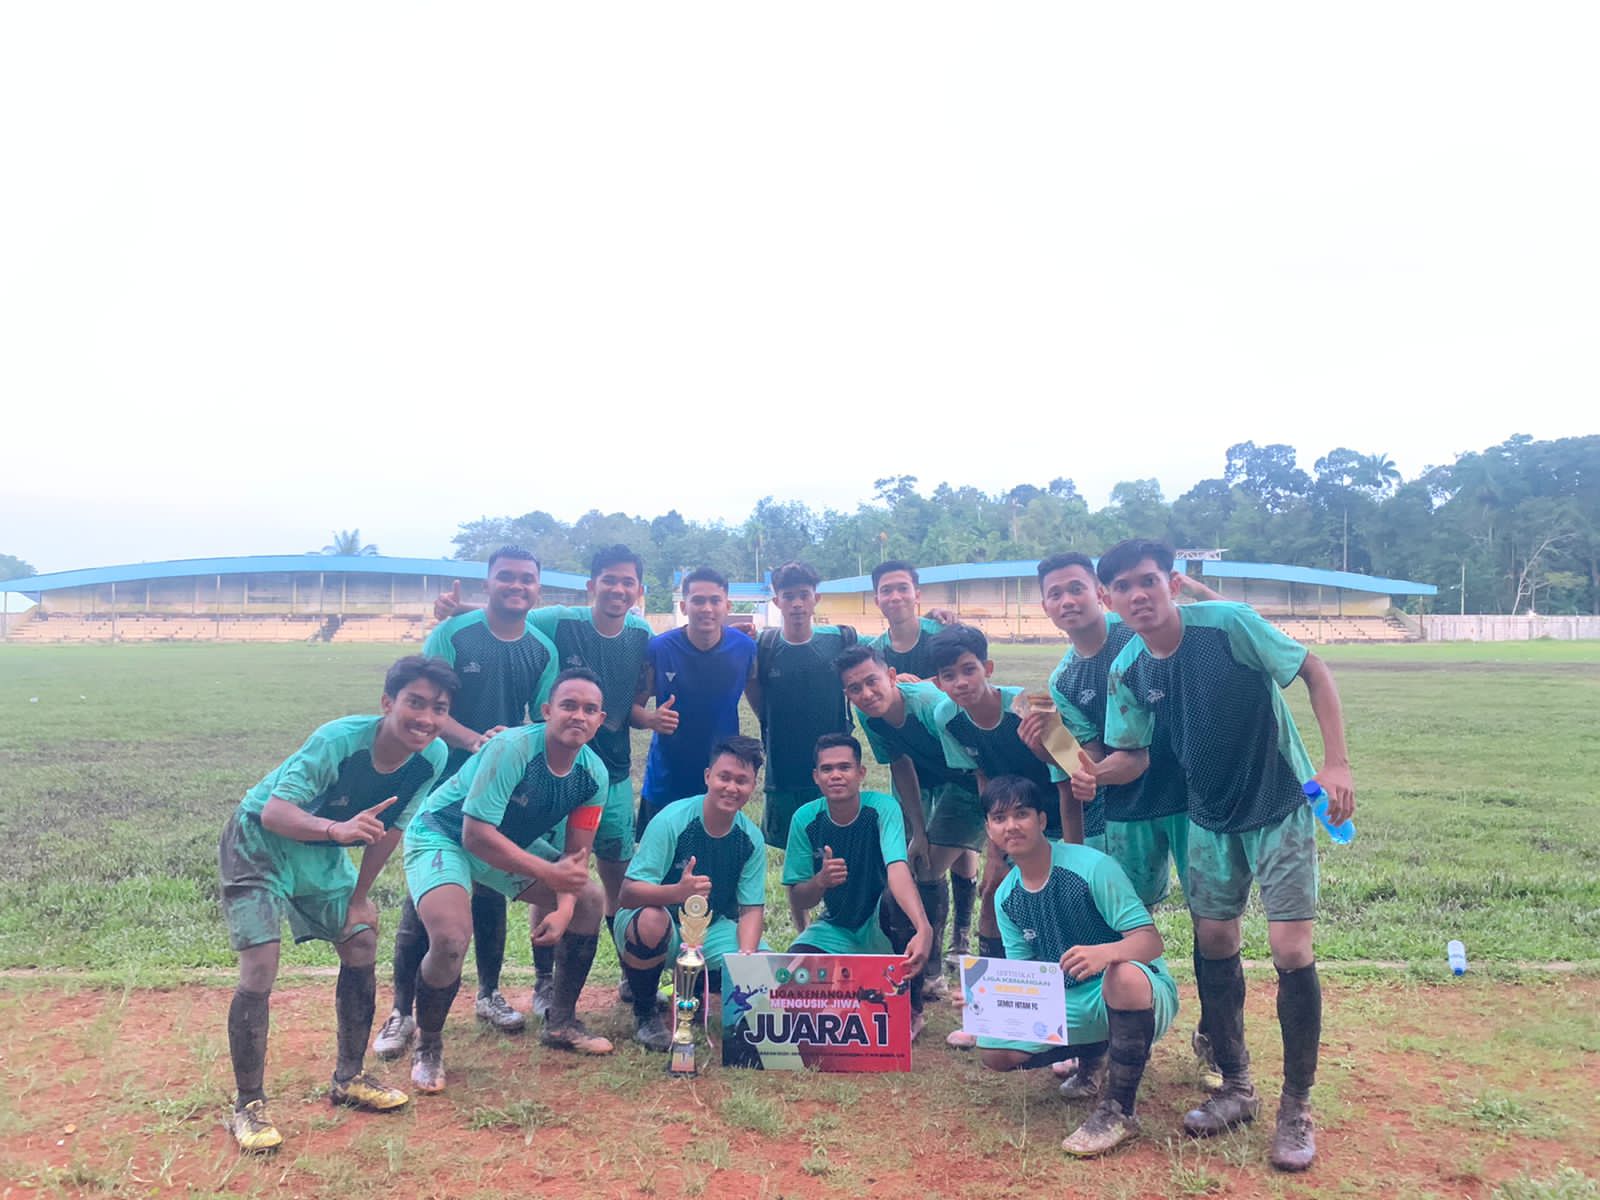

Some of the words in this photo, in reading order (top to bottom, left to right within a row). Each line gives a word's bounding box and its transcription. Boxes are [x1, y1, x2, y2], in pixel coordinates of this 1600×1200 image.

[431, 849, 444, 871] 4
[769, 989, 795, 999] LIGA
[771, 999, 829, 1009] MENGUSIK
[831, 999, 861, 1009] JIWA
[744, 1012, 871, 1046] JUARA
[872, 1012, 889, 1047] 1
